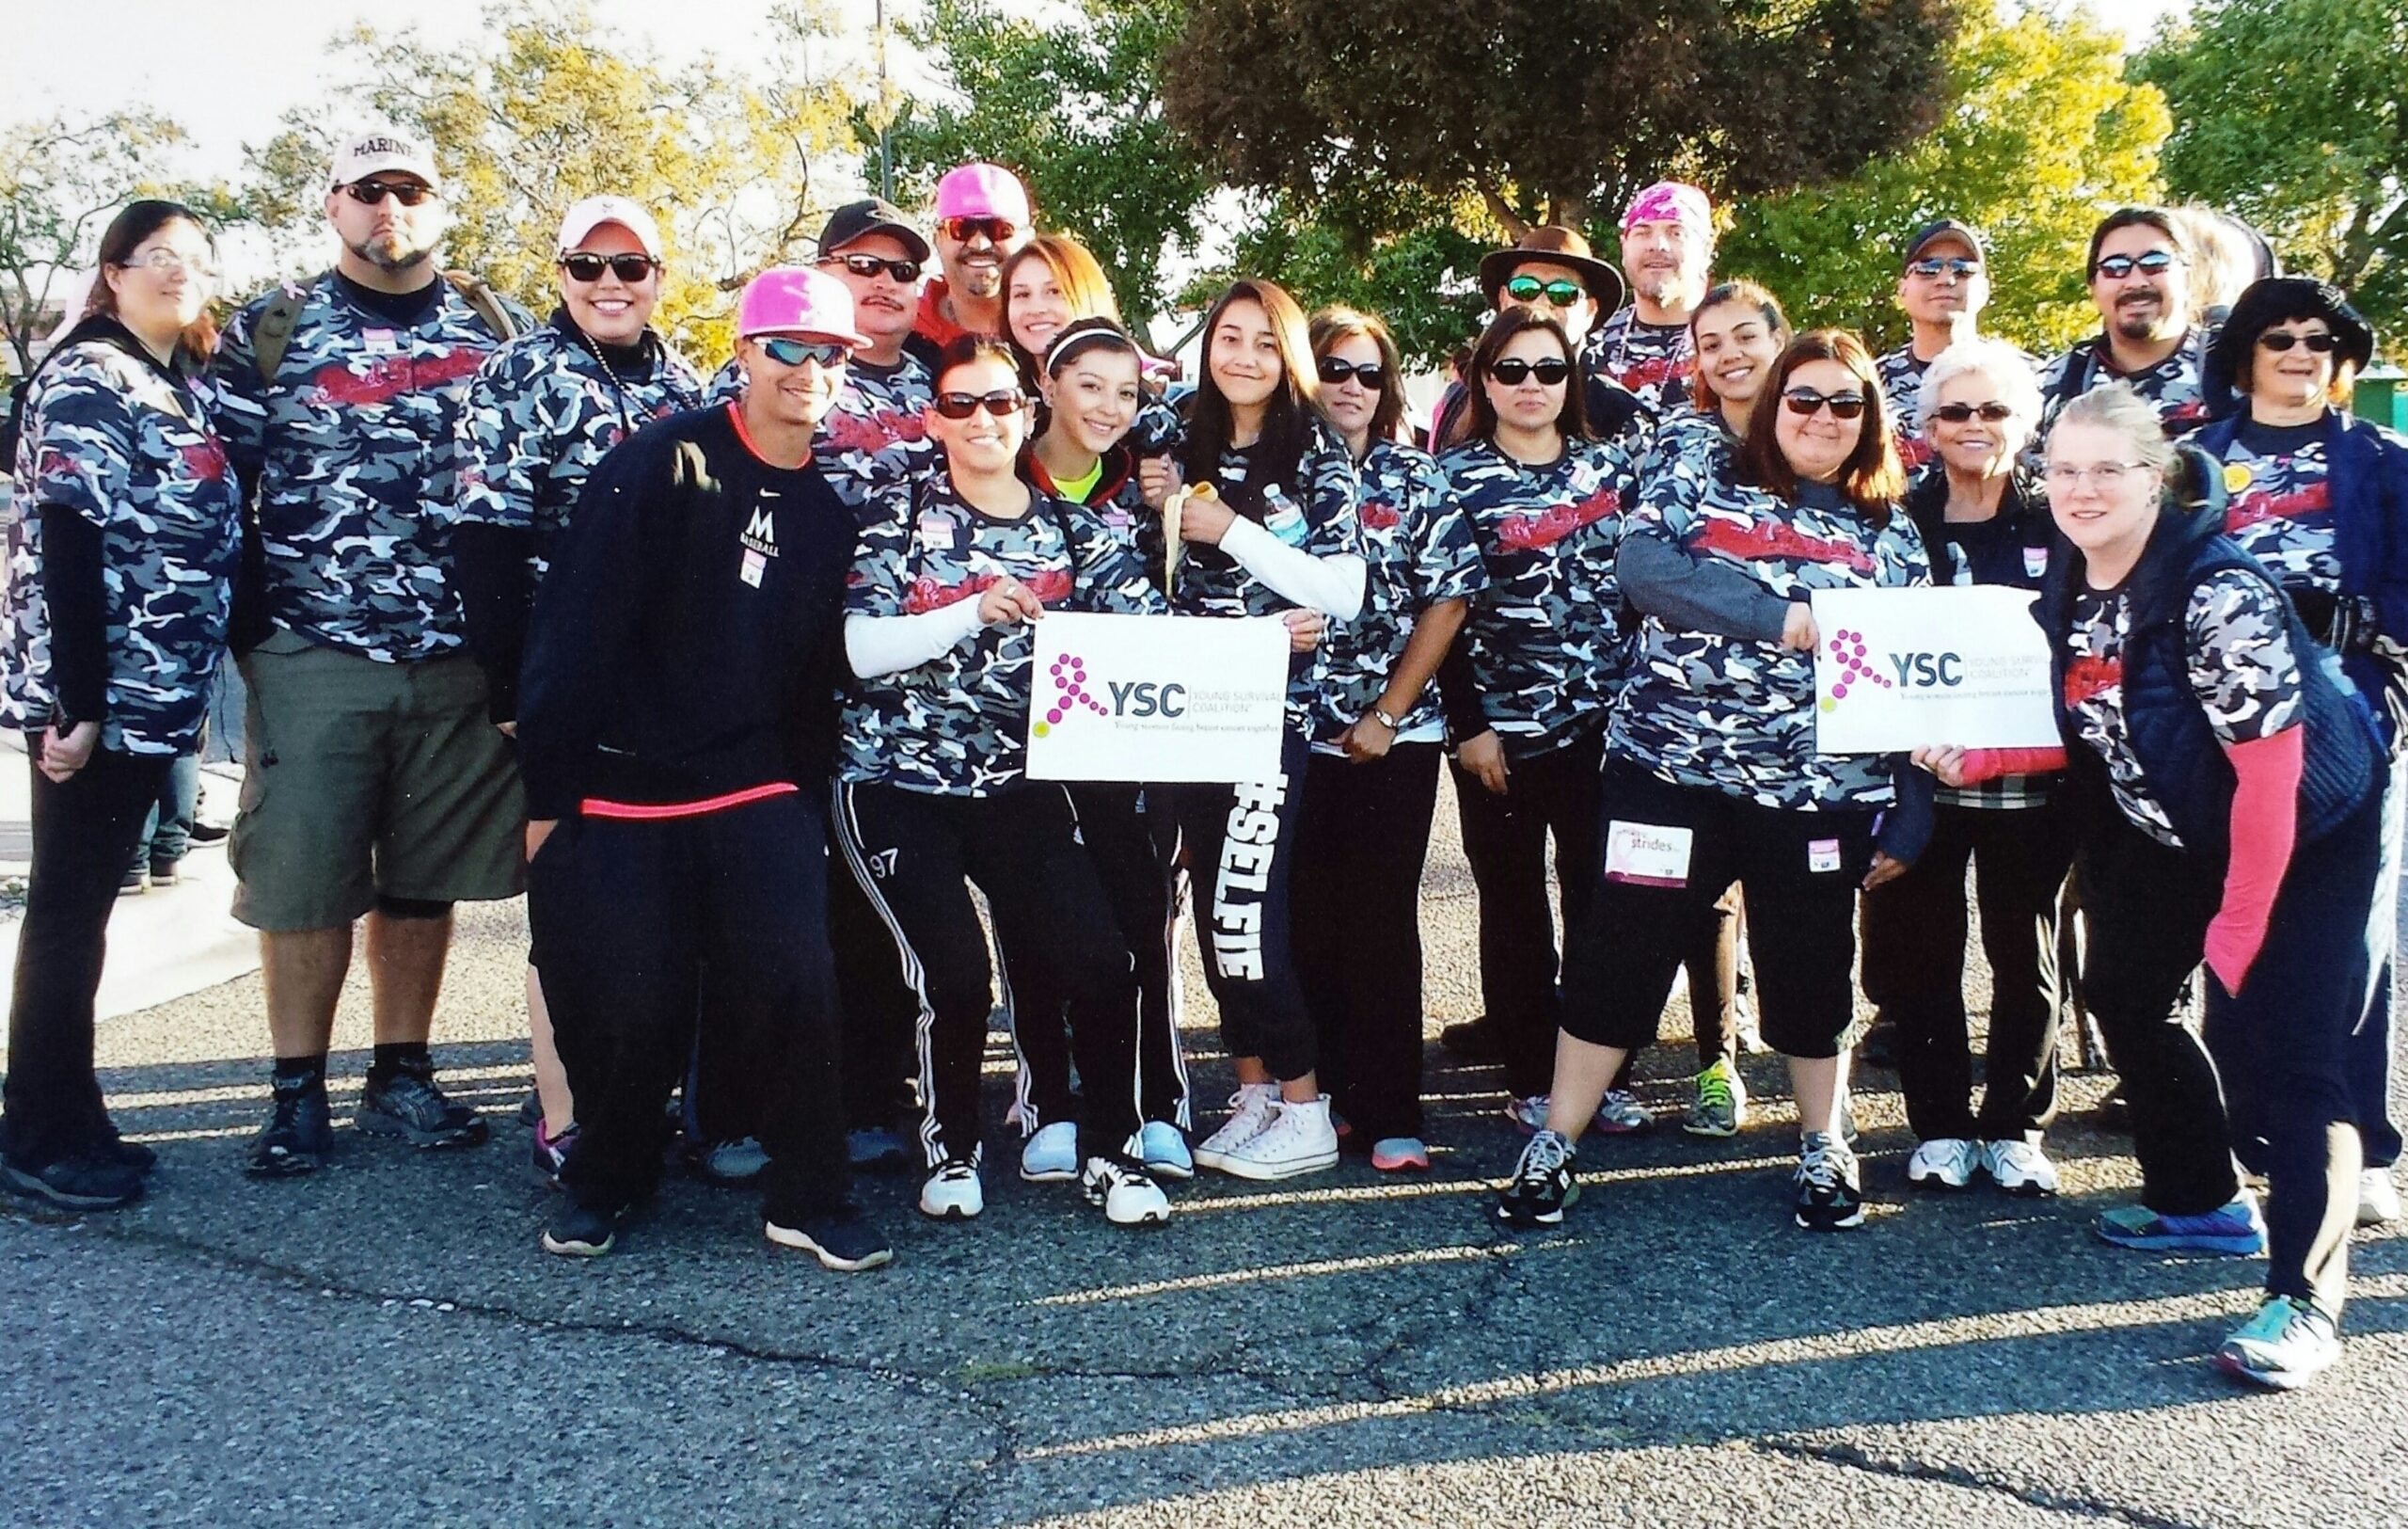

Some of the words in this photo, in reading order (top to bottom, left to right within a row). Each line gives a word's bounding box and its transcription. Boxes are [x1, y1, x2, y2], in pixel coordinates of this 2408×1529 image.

[744, 504, 774, 544] M
[739, 532, 780, 558] BASEBALL
[1889, 651, 1963, 688] YSC
[1107, 681, 1186, 718] YSC
[1193, 691, 1230, 702] YOUNG
[1631, 837, 1672, 852] strides
[869, 847, 898, 879] 97
